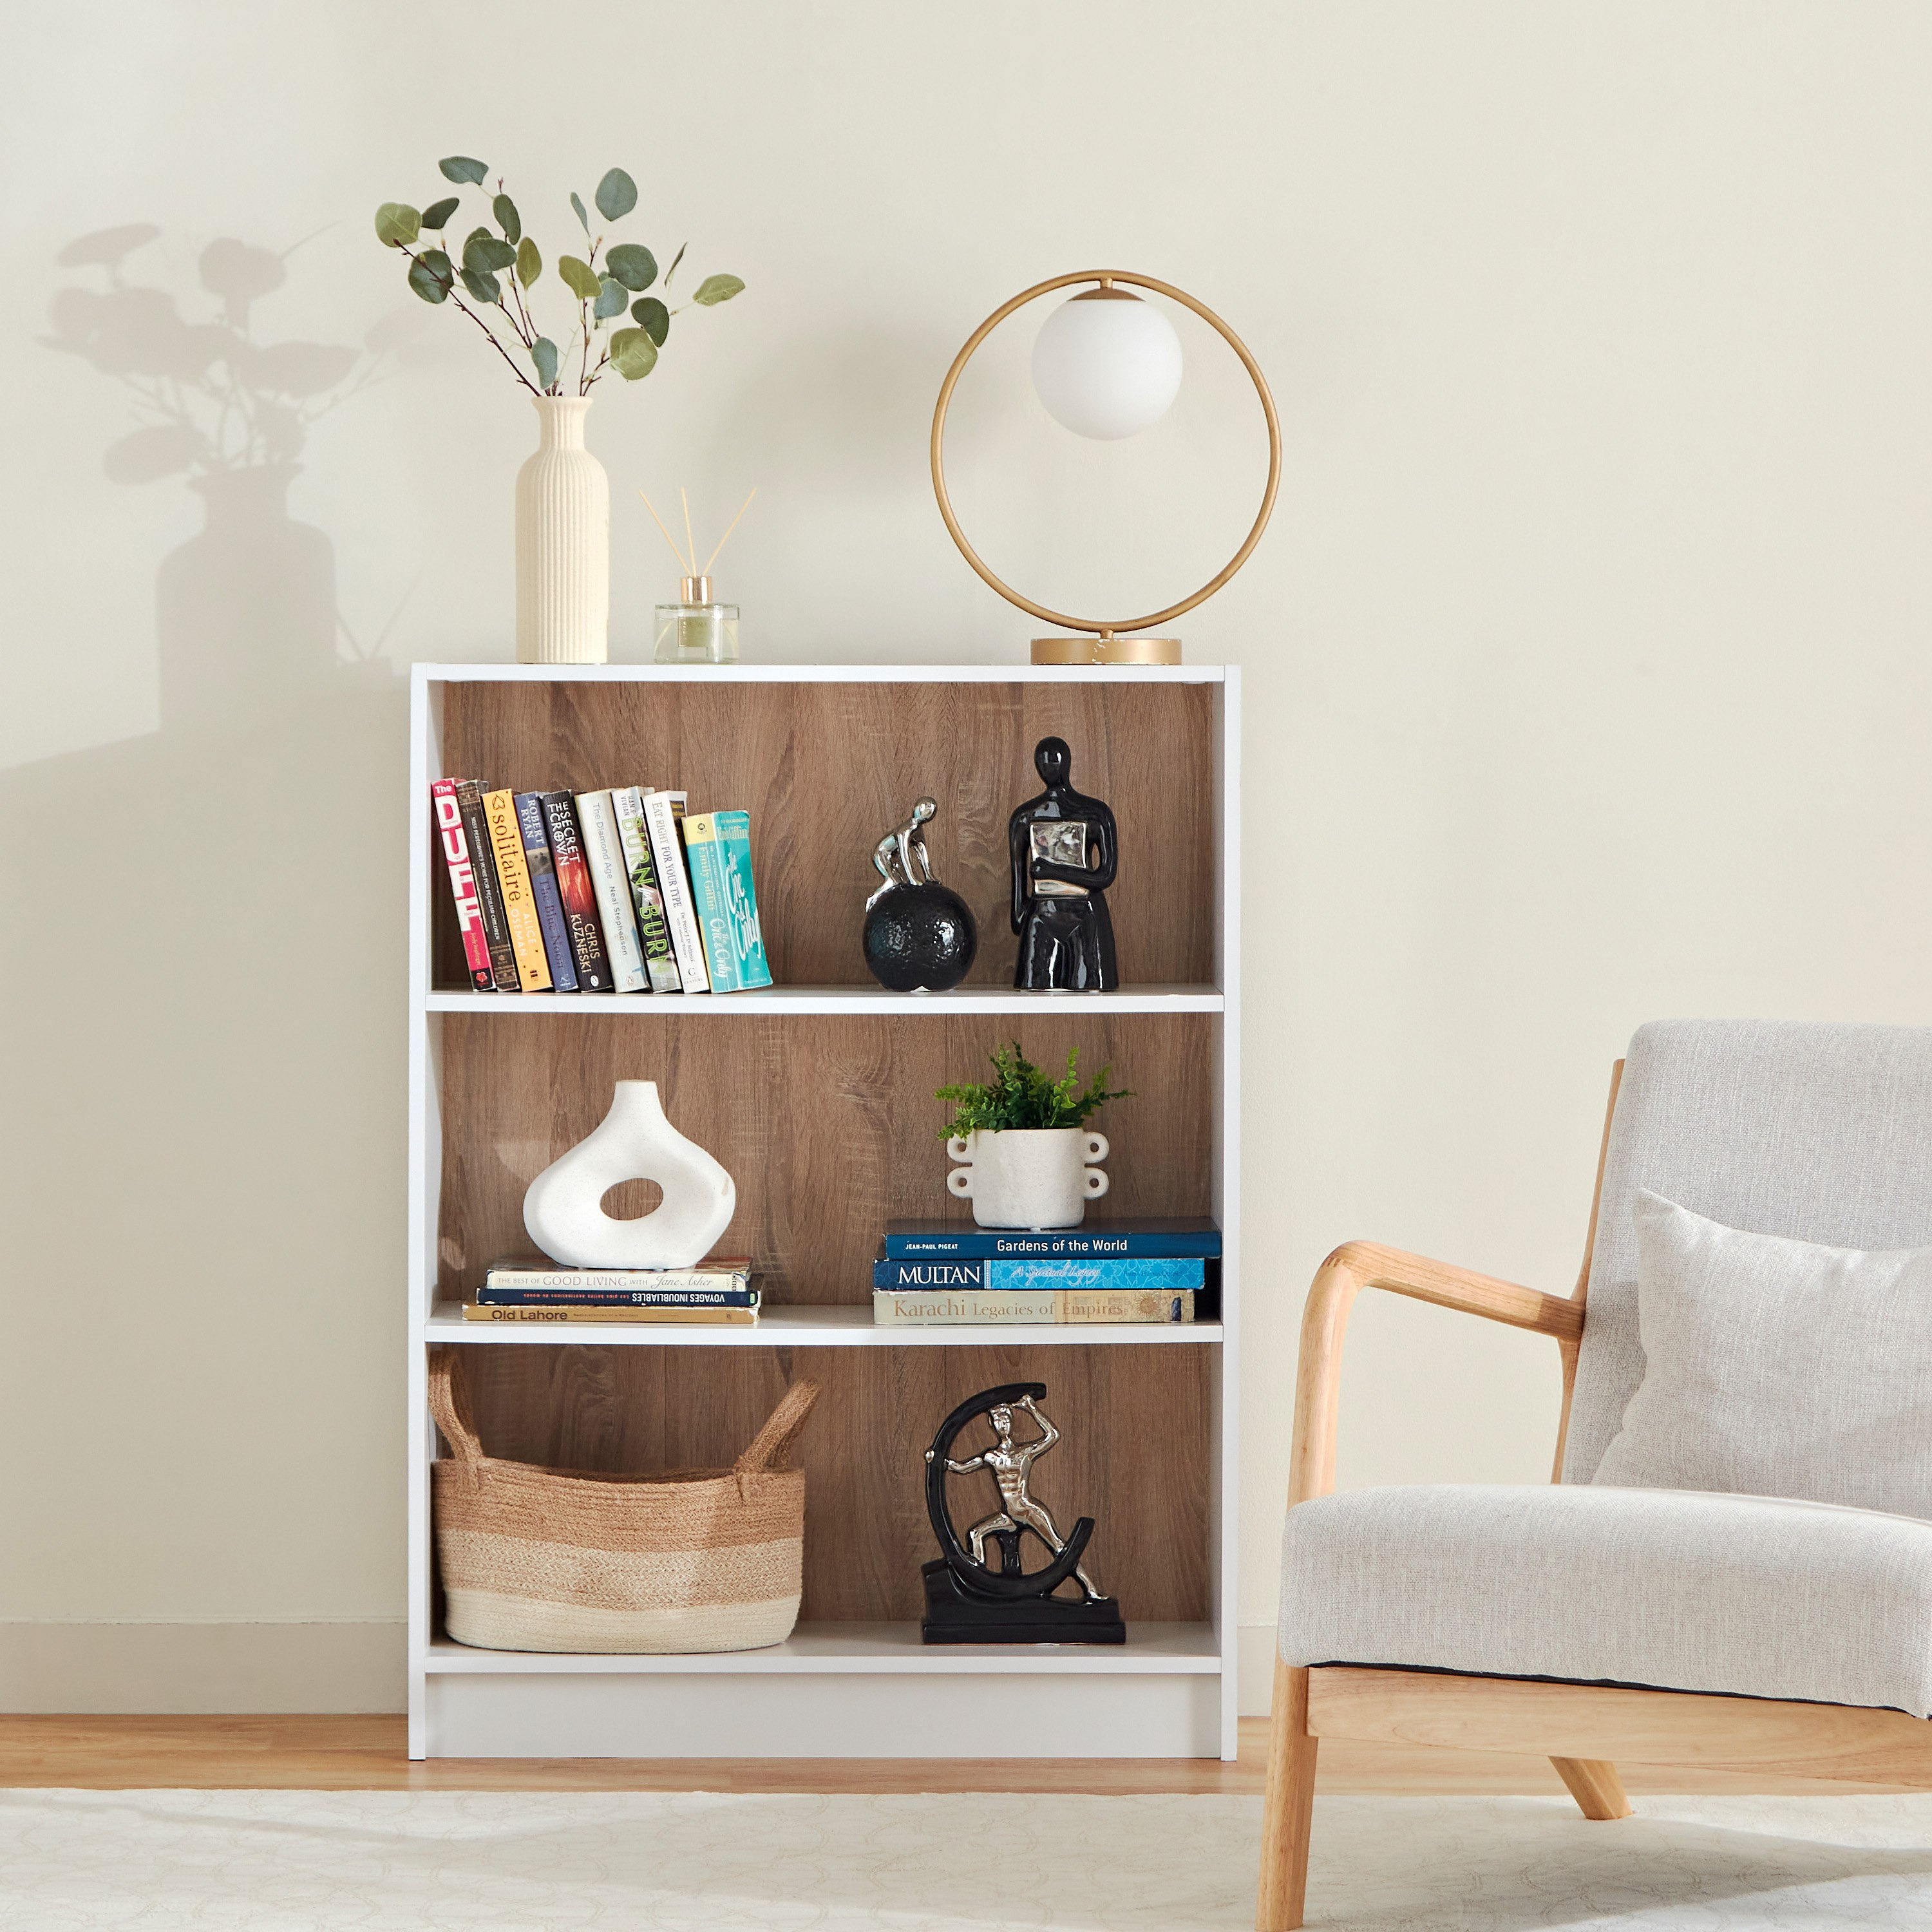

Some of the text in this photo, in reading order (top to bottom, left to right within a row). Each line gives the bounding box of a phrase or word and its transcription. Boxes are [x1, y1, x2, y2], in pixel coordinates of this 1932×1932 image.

[435, 785, 451, 793] The
[547, 801, 569, 813] THE
[621, 796, 630, 816] VIVIAN
[521, 808, 534, 838] RYAN
[528, 799, 544, 844] ROBERT
[549, 813, 570, 866] CROWN
[560, 811, 580, 863] SECRET
[435, 795, 480, 932] DUFF
[492, 815, 521, 901] solitaire
[596, 822, 611, 860] Diamond
[604, 862, 612, 880] Age
[652, 802, 682, 908] EAT RIGHT FOR YOUR TYPE
[621, 817, 670, 973] BURN for BURN
[511, 909, 527, 957] OSEMAN
[523, 913, 537, 944] ALICE
[540, 881, 564, 968] The Blue Noon
[609, 886, 627, 956] Neal Stephenson
[571, 913, 592, 973] KUZNESKI
[585, 923, 600, 959] CHRIS
[714, 949, 732, 978] Only
[997, 1239, 1127, 1251] Gardens of the World
[543, 1276, 582, 1285] GOOD
[587, 1276, 627, 1286] LIVING
[651, 1274, 679, 1289] Jane
[681, 1275, 713, 1286] Asher
[898, 1266, 980, 1283] MULTAN
[491, 1310, 567, 1320] Old Lahore
[632, 1293, 724, 1303] VOYAGES INOUBLIABLES
[894, 1298, 1122, 1318] Karachi Legacies of Empires
